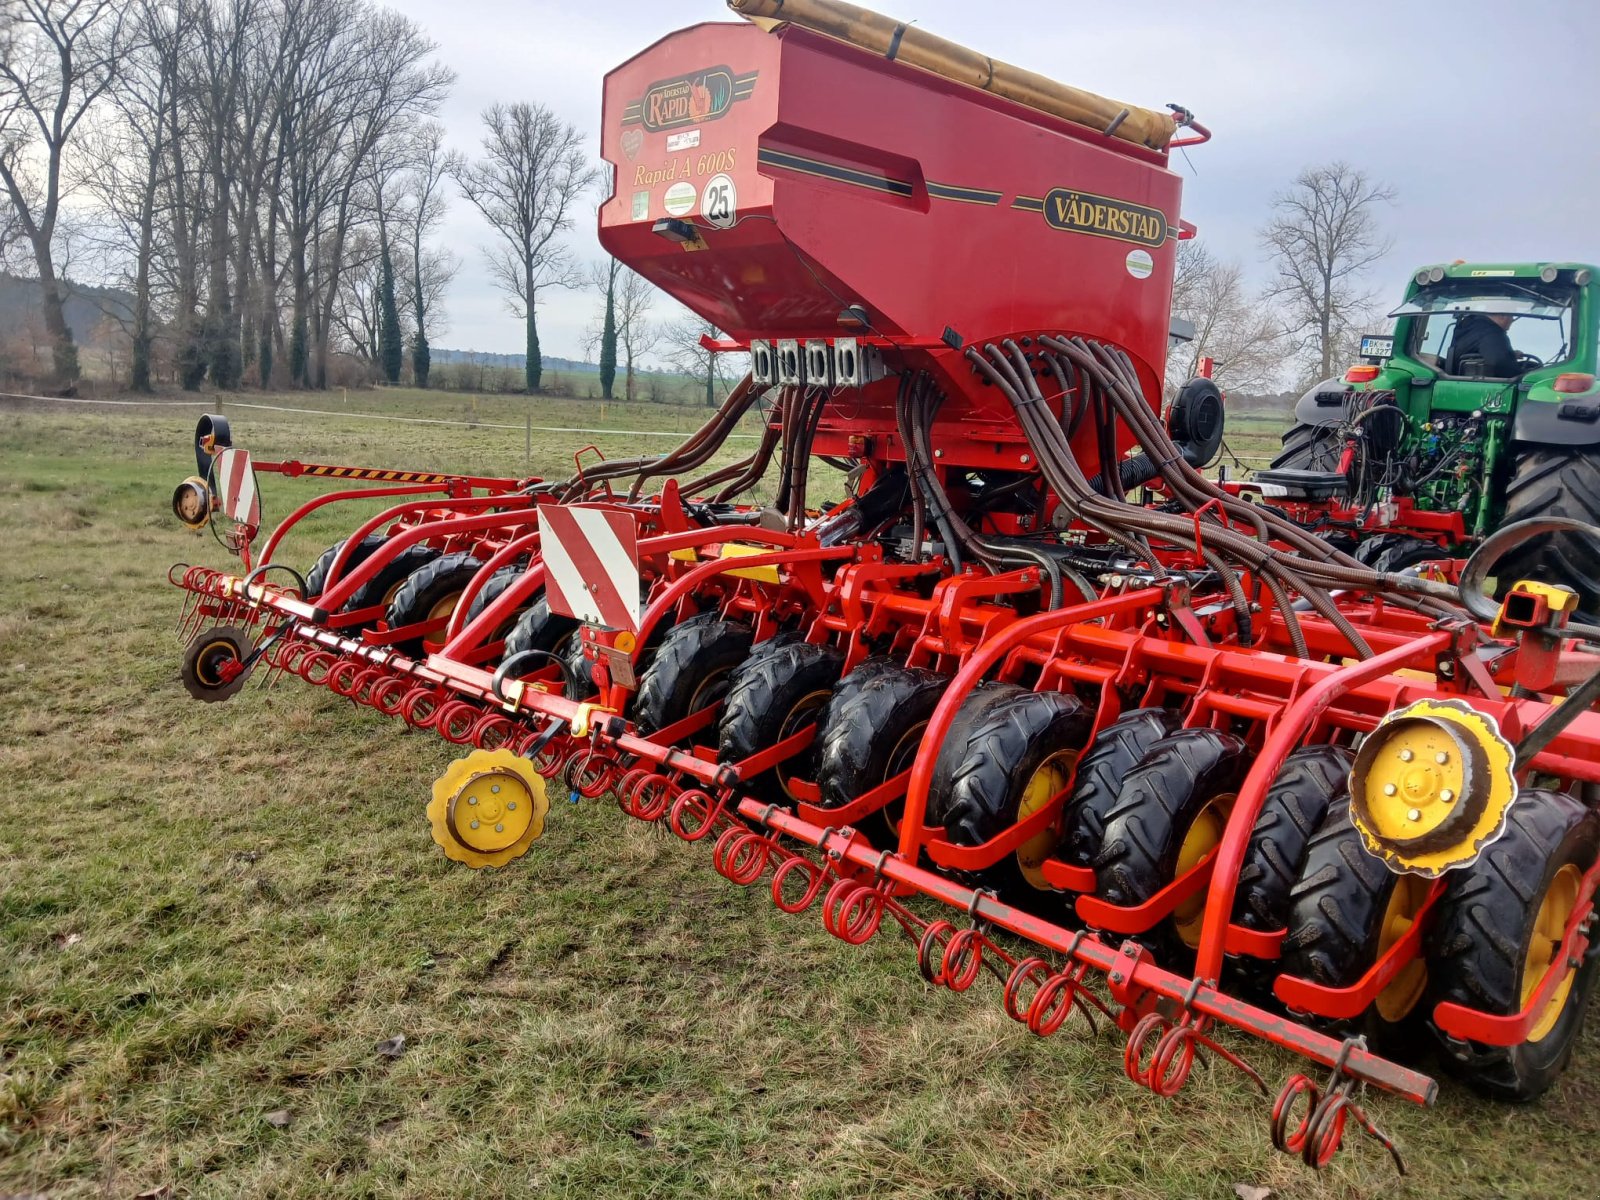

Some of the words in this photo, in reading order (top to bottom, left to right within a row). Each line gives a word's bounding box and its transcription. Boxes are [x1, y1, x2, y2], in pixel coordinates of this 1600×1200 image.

[649, 92, 688, 126] RAPID
[634, 159, 678, 188] Rapid
[679, 156, 691, 179] A
[697, 148, 736, 175] 600S
[709, 185, 729, 220] 25
[1055, 194, 1161, 240] VÄDERSTAD
